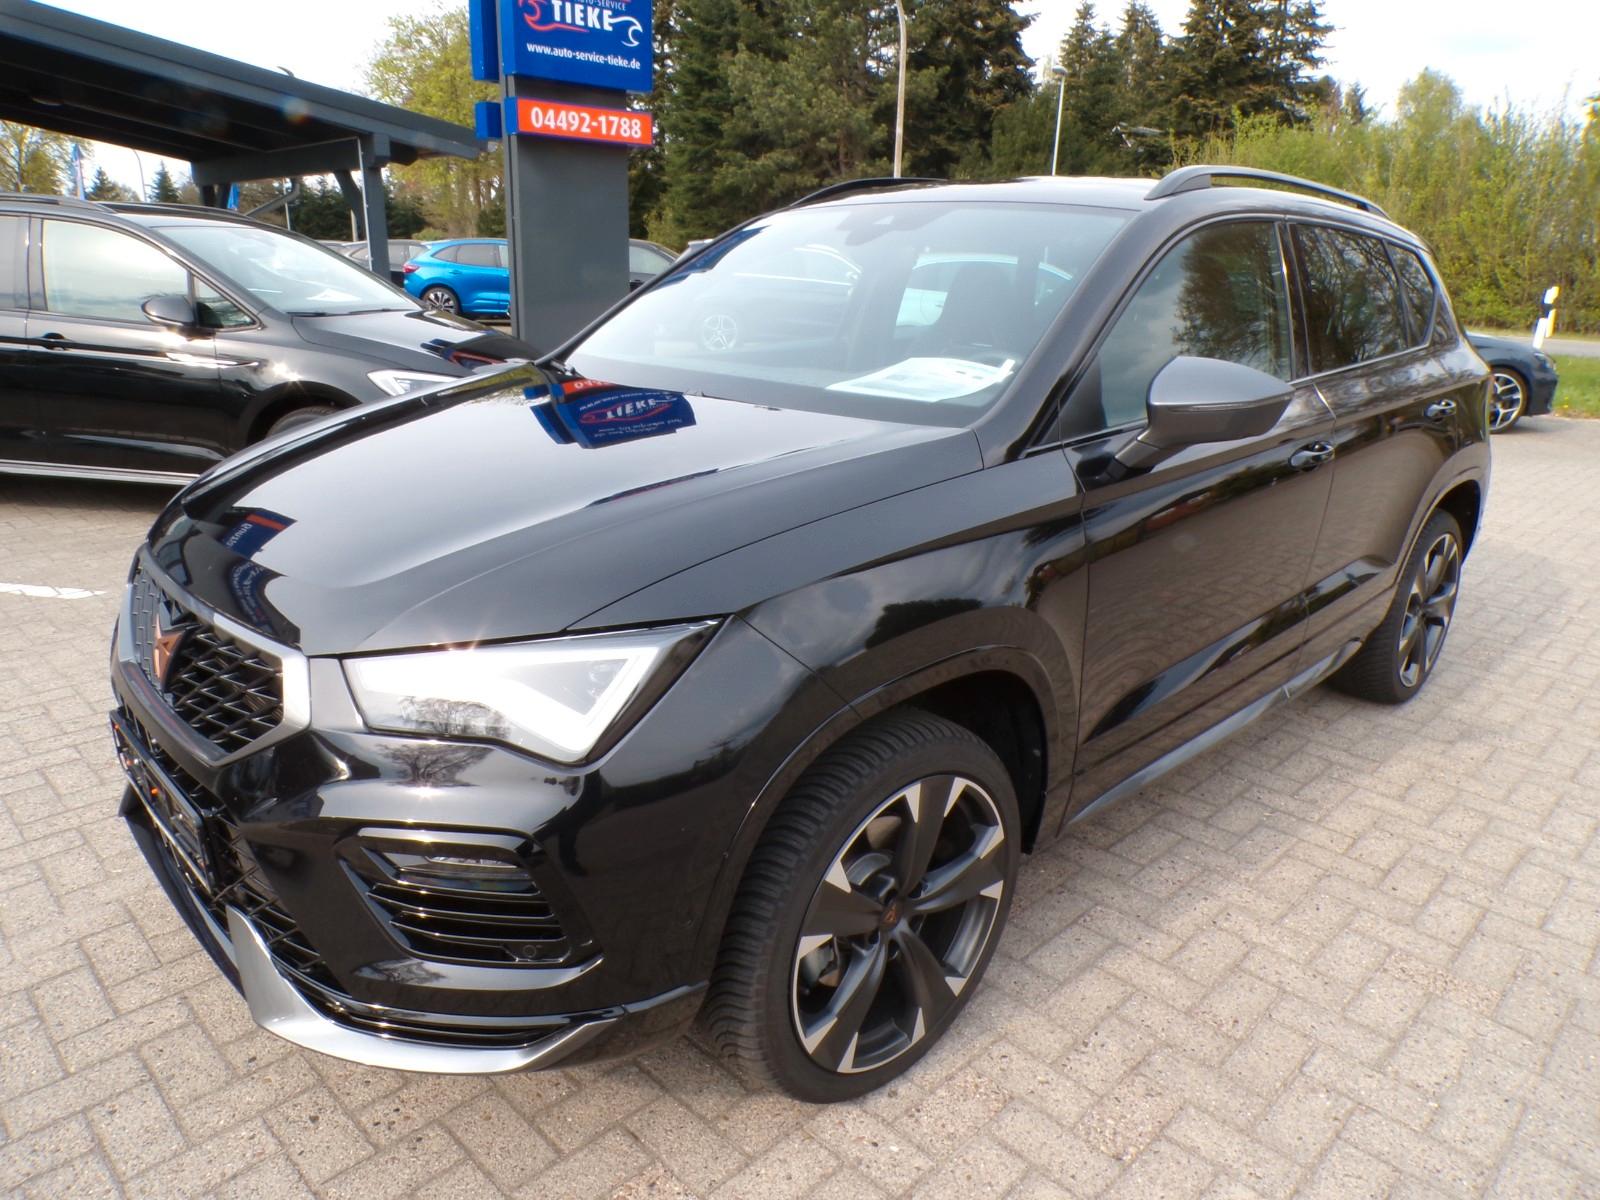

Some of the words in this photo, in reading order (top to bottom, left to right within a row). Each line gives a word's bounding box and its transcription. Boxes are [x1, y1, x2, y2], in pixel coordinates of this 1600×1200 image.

[551, 0, 613, 31] TIEKE
[526, 42, 641, 70] www.auto-service-tieke.de
[530, 106, 642, 139] 04492-1788
